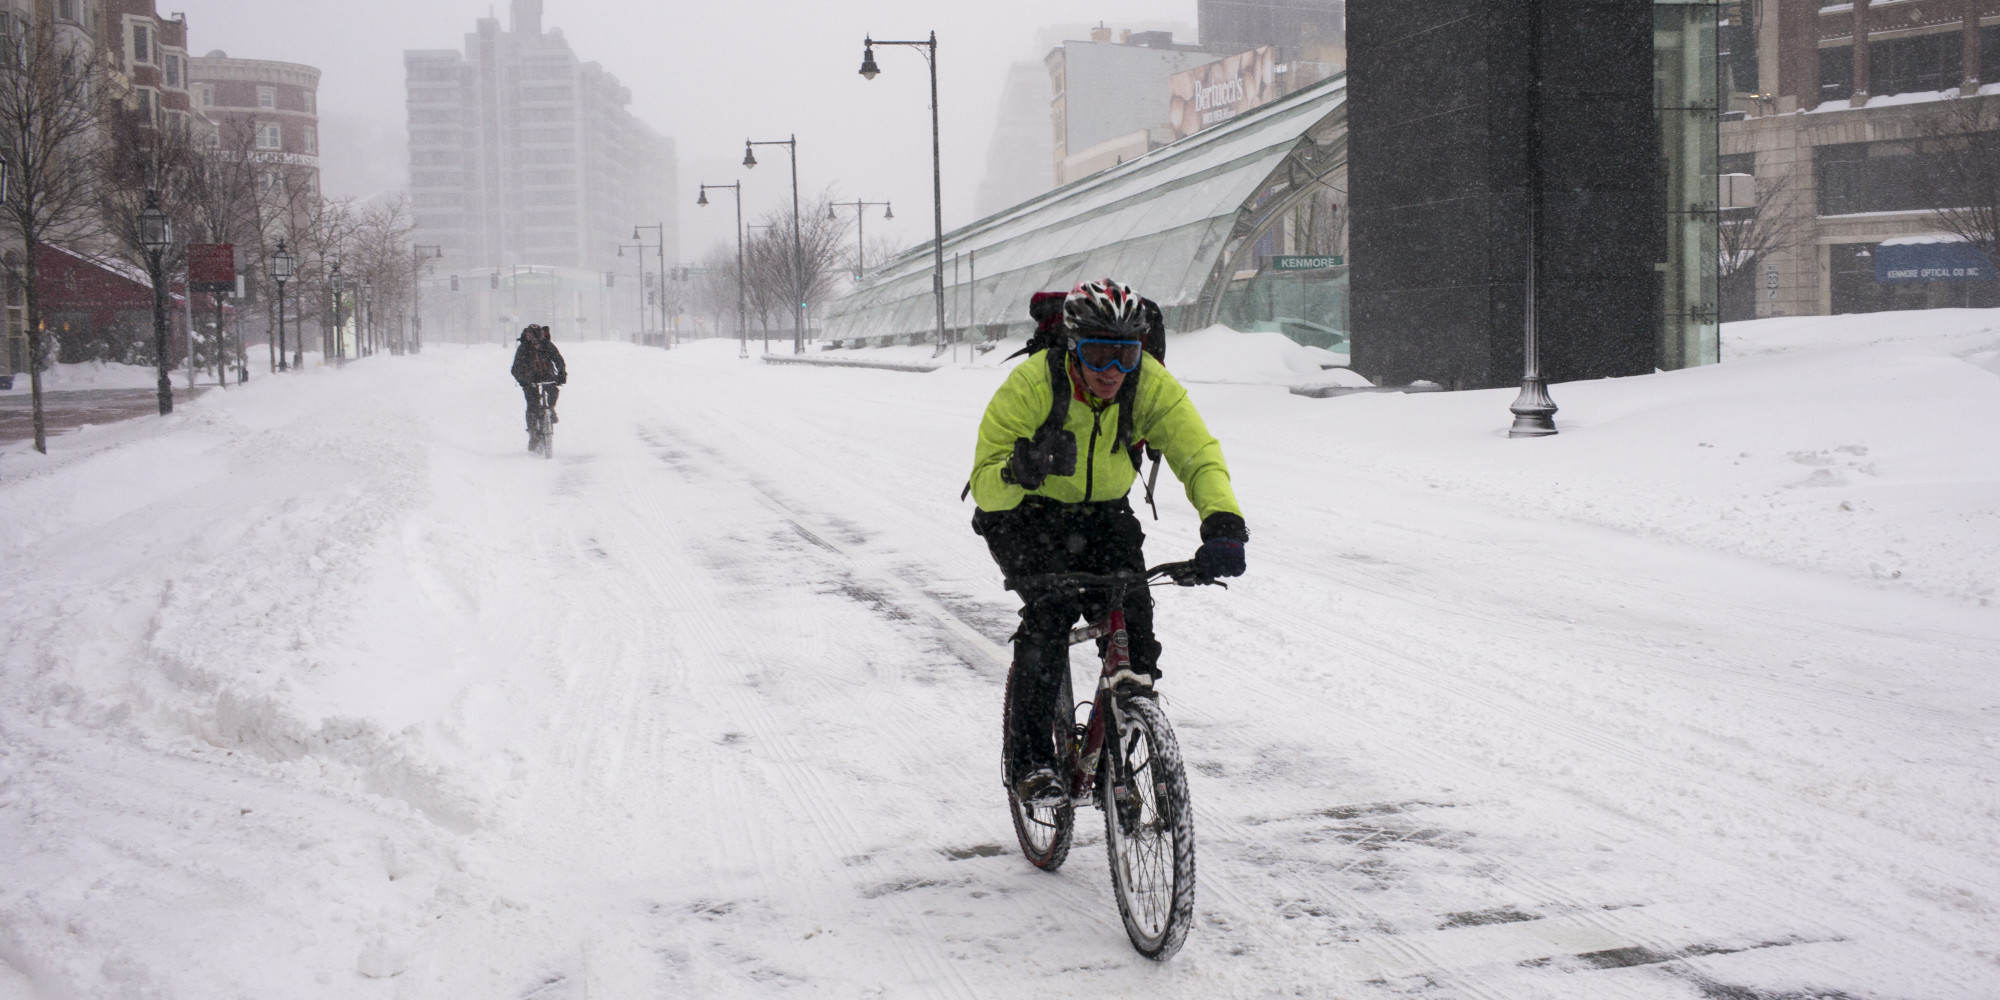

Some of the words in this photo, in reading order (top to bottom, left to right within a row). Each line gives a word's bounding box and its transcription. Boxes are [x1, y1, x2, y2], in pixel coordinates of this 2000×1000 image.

[1195, 76, 1242, 111] Bertucci's
[1281, 258, 1335, 268] KENMORE
[1887, 269, 1918, 279] KENMORE
[1921, 268, 1951, 277] OPTICAL
